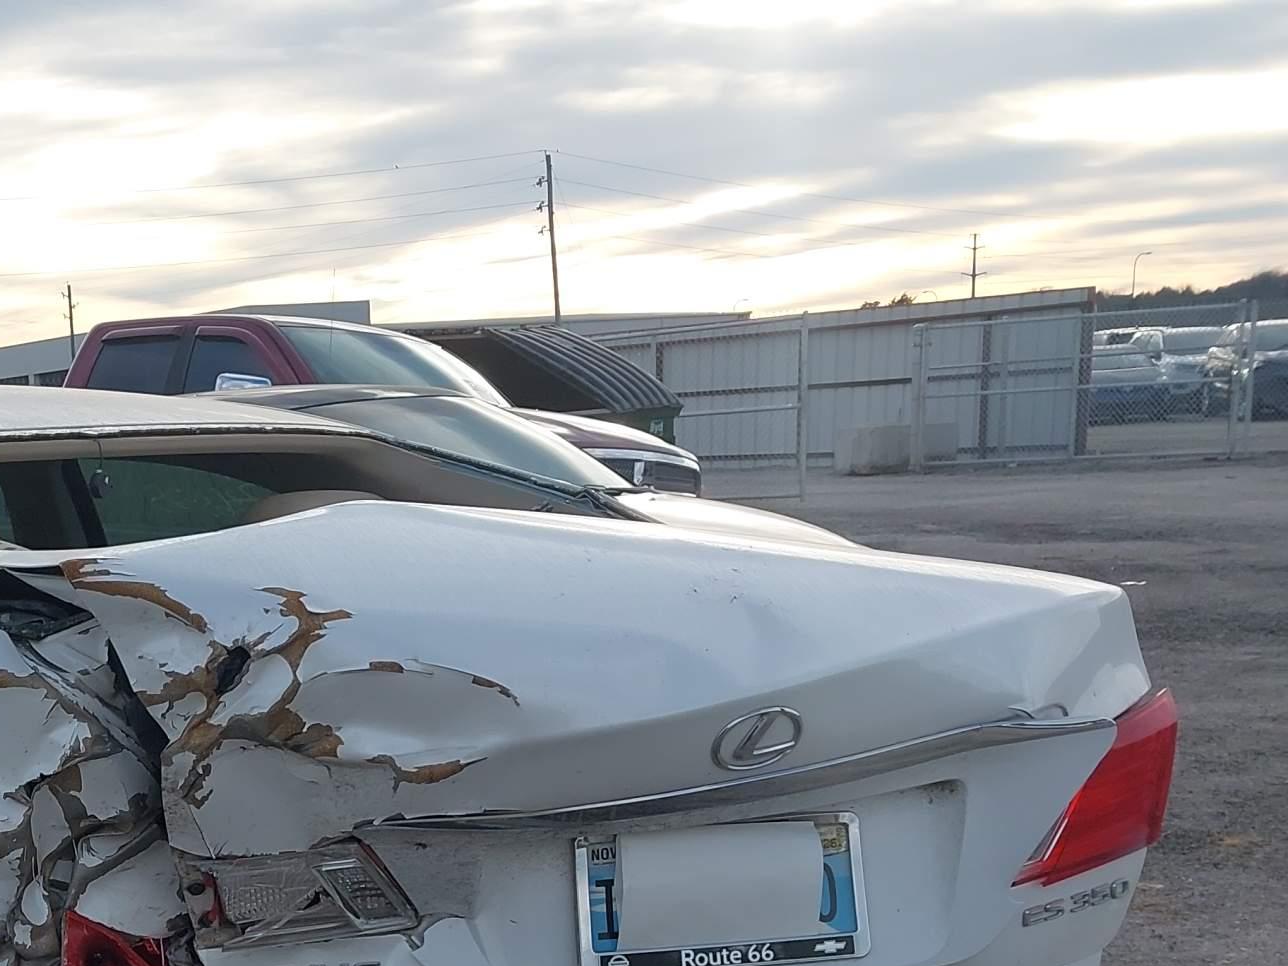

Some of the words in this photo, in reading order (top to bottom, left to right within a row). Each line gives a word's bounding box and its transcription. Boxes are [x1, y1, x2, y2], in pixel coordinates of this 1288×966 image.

[1022, 898, 1065, 927] ES
[1070, 877, 1129, 913] 350
[747, 943, 775, 962] 66
